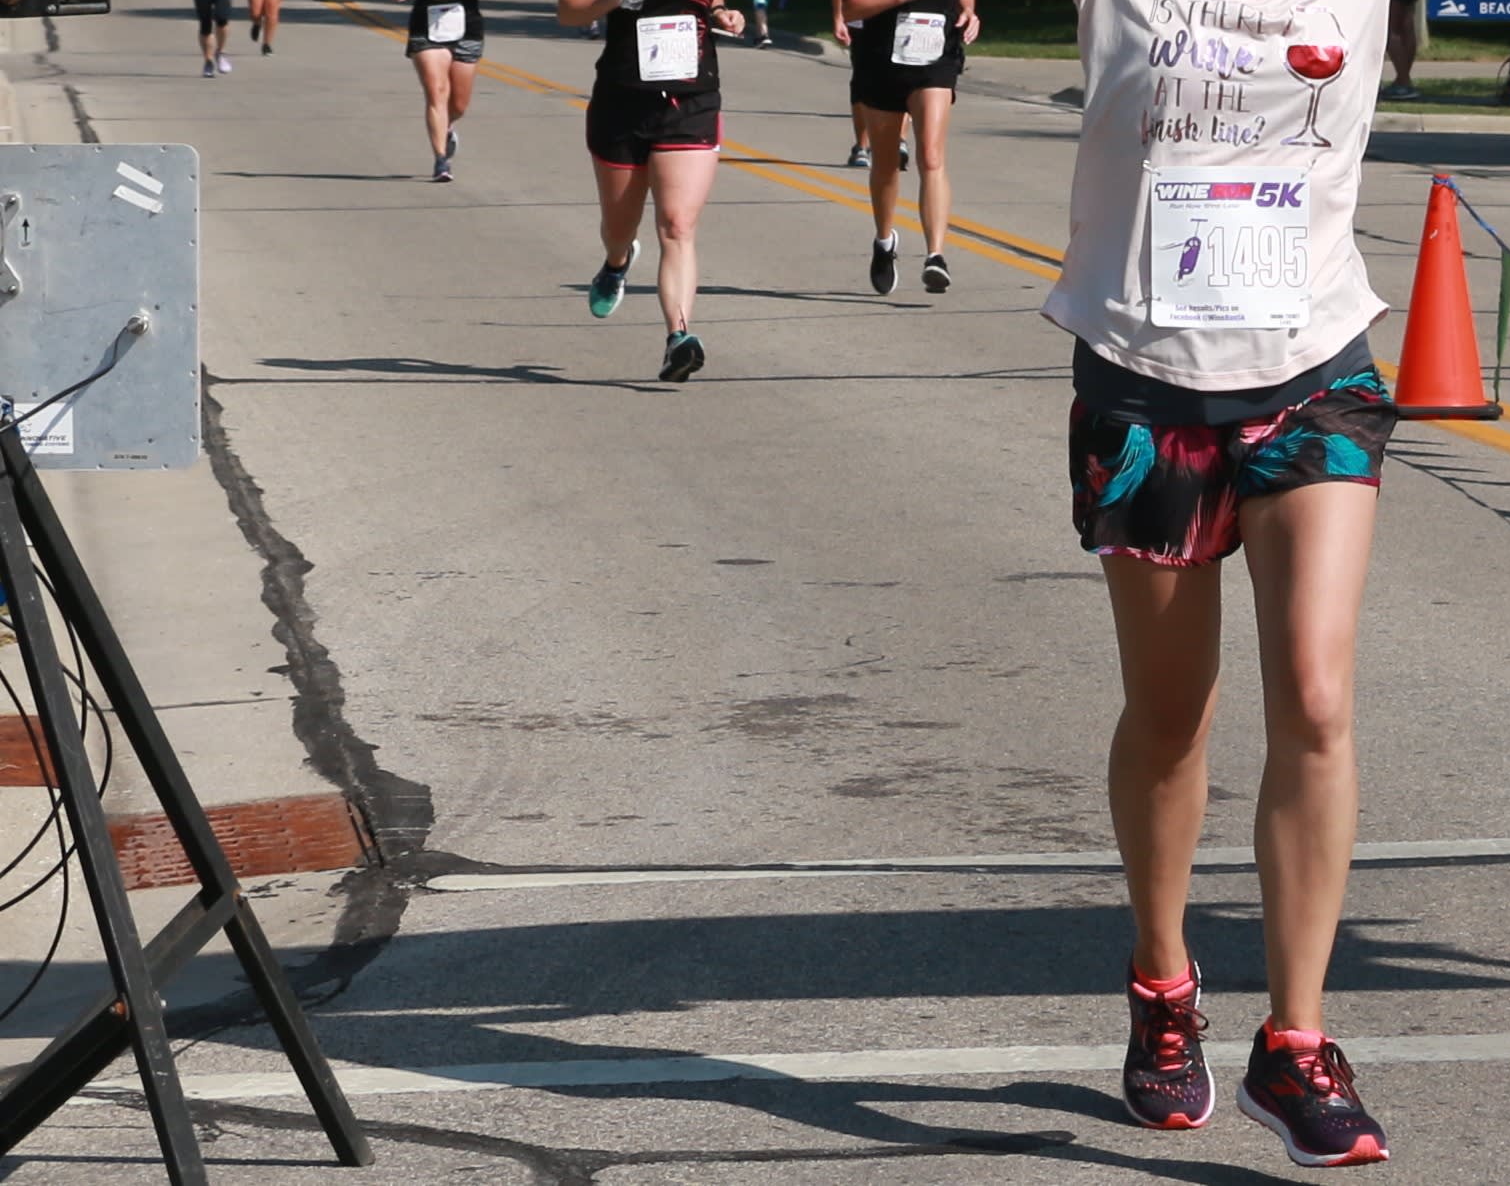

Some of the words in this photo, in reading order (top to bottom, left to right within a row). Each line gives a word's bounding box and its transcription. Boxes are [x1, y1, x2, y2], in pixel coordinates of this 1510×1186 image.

[1184, 0, 1270, 35] THERE
[1150, 29, 1263, 79] wine
[1155, 76, 1187, 107] AT
[1202, 79, 1251, 113] THE
[1141, 110, 1202, 145] finish
[1211, 115, 1266, 146] line?
[1157, 184, 1208, 199] WINE
[1256, 183, 1304, 208] 5K
[1207, 226, 1308, 288] 1495
